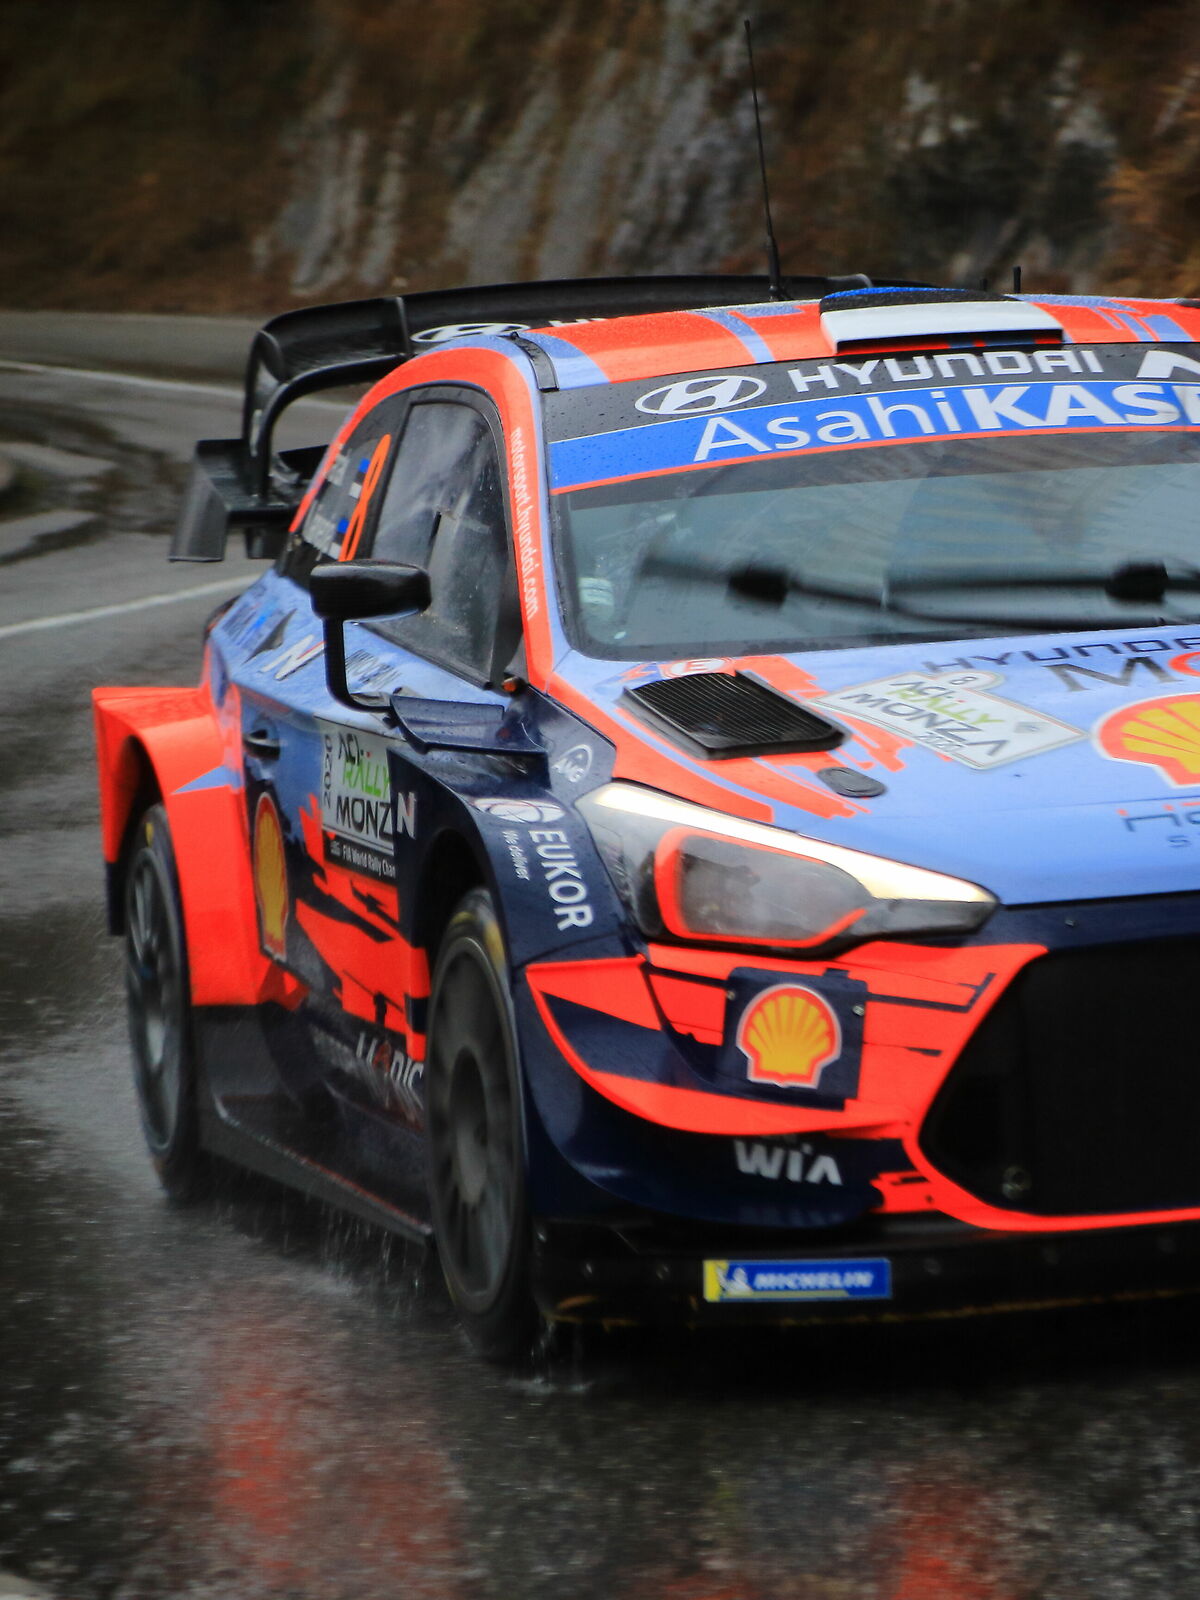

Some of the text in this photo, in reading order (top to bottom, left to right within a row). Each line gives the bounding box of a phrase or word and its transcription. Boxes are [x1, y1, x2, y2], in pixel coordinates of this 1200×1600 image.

[787, 350, 1104, 393] HYUNDAI
[511, 427, 539, 621] motorsport.hyundai.com
[949, 676, 977, 687] 8
[840, 693, 1009, 757] MONZA
[886, 688, 1006, 725] RALLY
[324, 734, 333, 809] 2020
[336, 795, 393, 842] MONZ
[528, 829, 594, 932] EUKOR
[753, 1271, 875, 1292] MICHELIN
